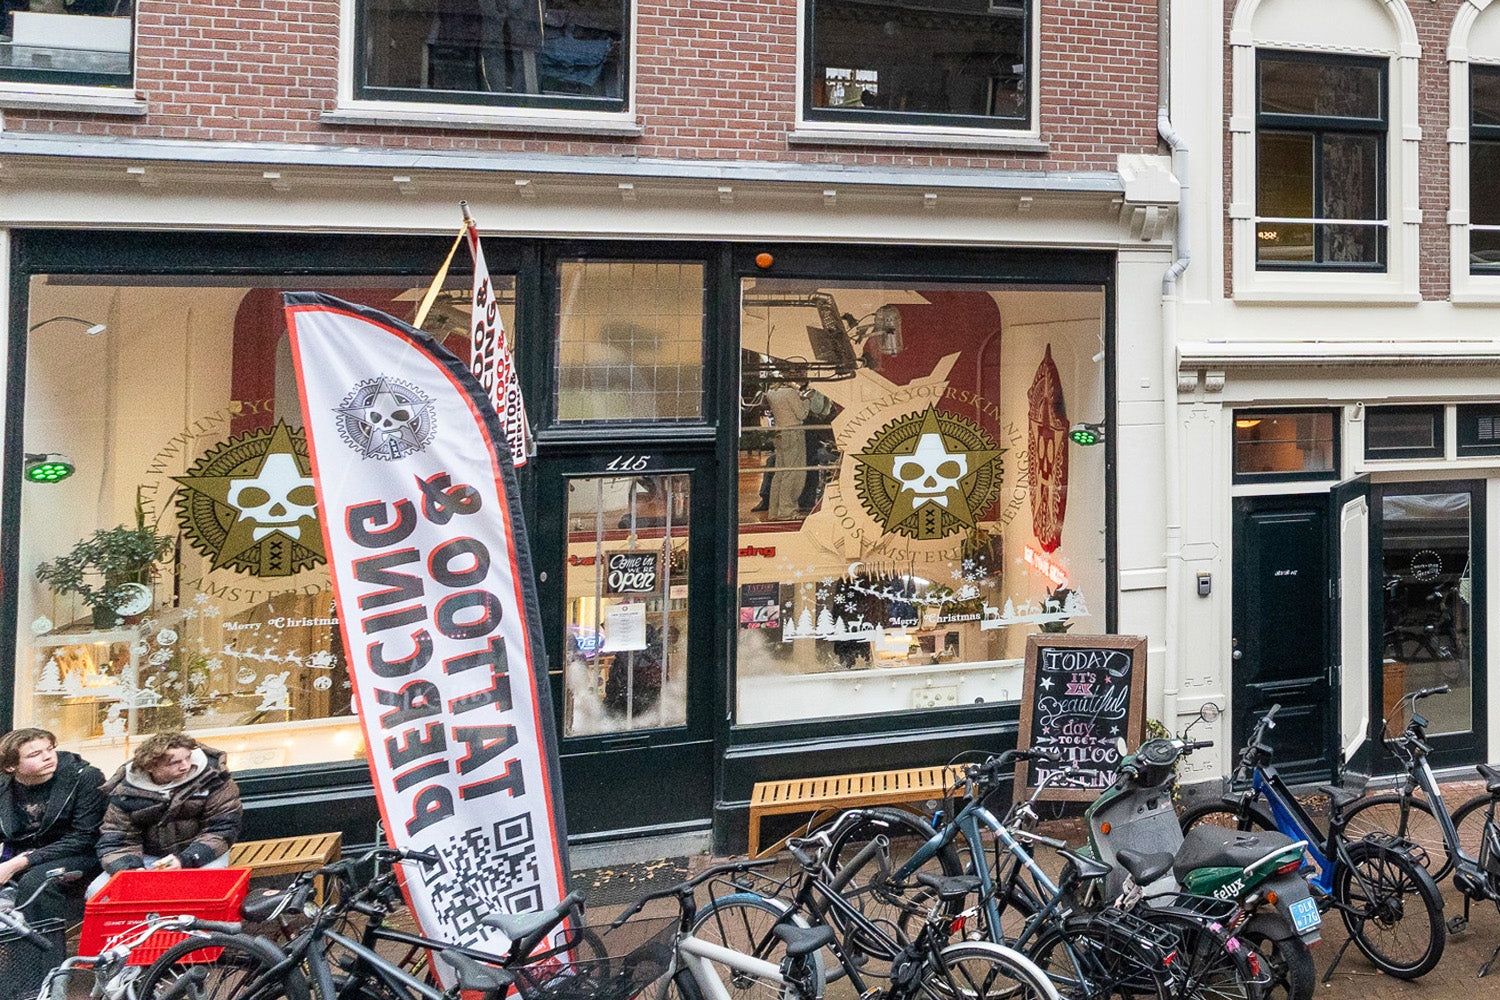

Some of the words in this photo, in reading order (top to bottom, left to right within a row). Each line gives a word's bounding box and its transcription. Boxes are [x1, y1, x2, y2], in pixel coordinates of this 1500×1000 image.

[606, 455, 651, 471] 115
[643, 554, 656, 567] in
[268, 617, 340, 629] Christma
[889, 616, 918, 626] Merry
[922, 613, 981, 624] Christmas
[1046, 651, 1115, 670] TODAY
[1071, 672, 1096, 683] IT'S
[1038, 685, 1129, 723] Beautiful
[1063, 719, 1095, 737] day
[1213, 878, 1245, 900] felyx
